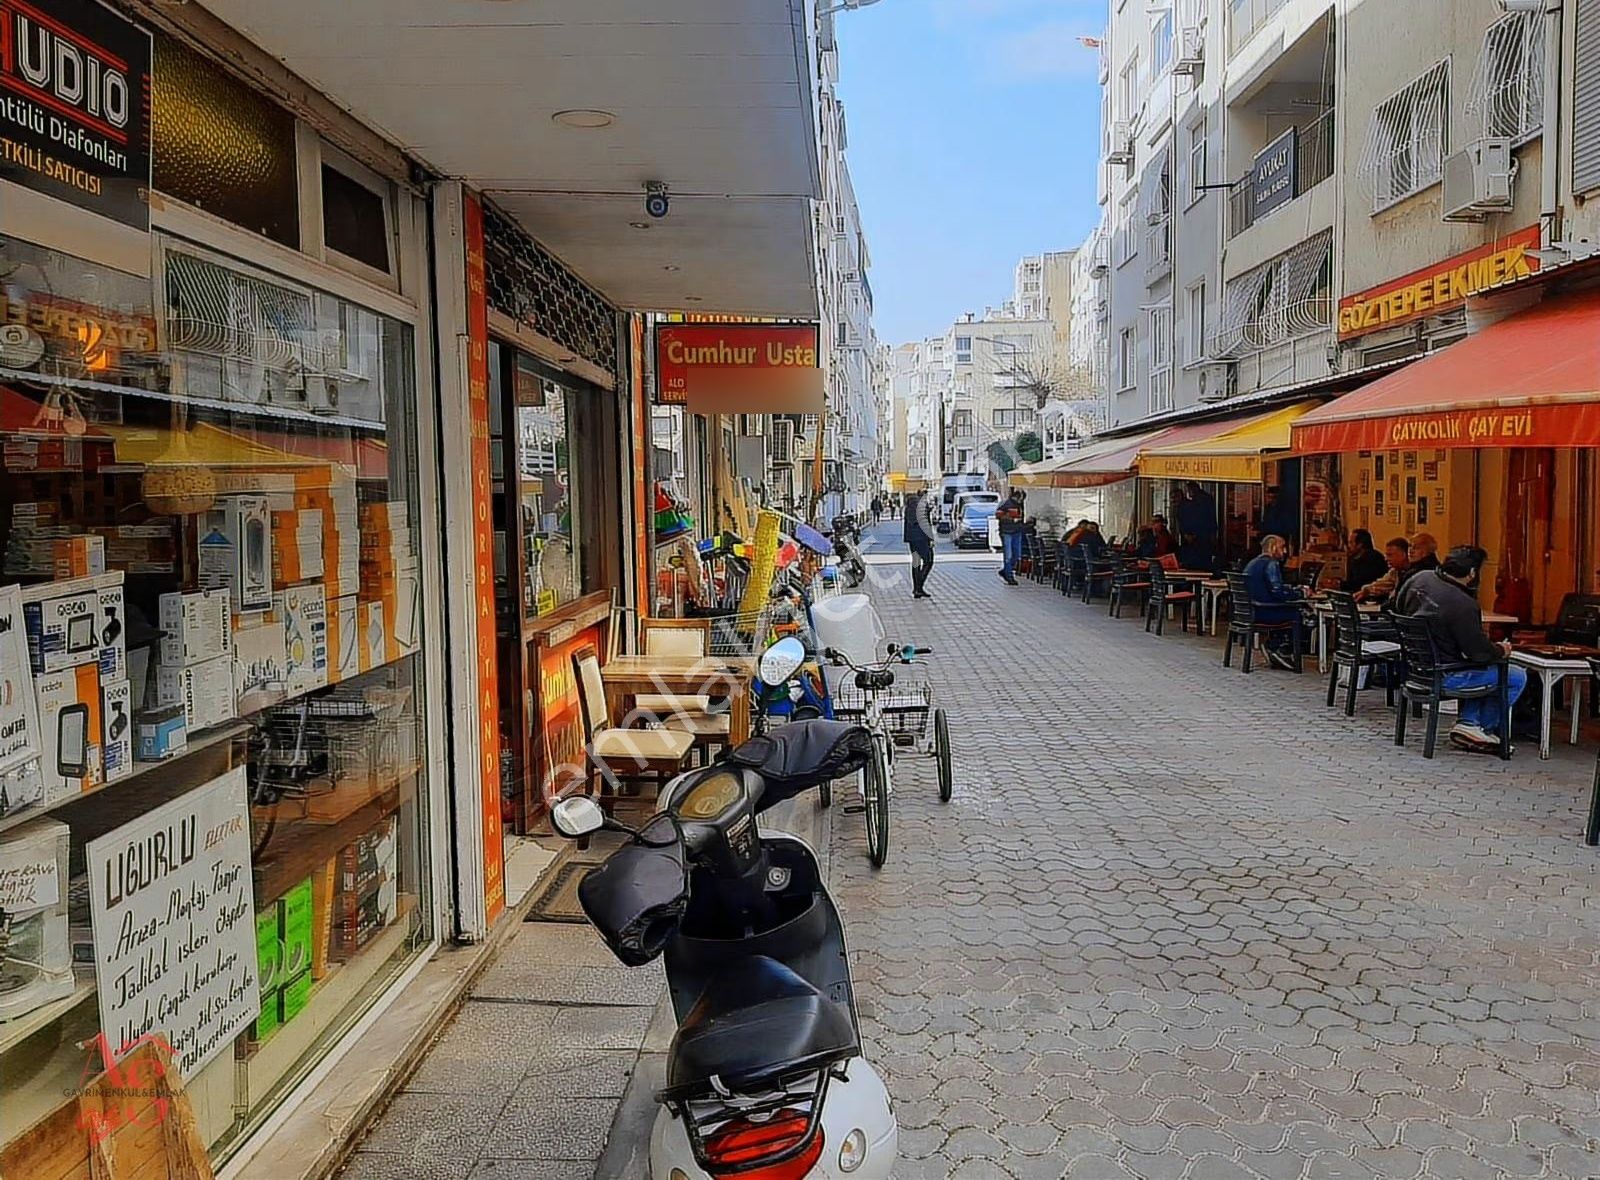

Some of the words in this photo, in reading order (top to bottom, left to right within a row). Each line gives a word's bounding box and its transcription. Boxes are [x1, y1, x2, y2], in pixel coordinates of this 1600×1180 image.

[0, 138, 42, 172] TKİLİ
[45, 158, 101, 196] SATICISI
[50, 116, 127, 172] Diafonları
[1339, 277, 1434, 333] GÖZTEPE
[1433, 241, 1532, 305] EKMEK
[668, 340, 757, 365] Cumhur
[766, 341, 815, 367] Usta
[1392, 415, 1461, 445] ÇAYKOLİK
[1469, 415, 1498, 442] ÇAY
[1501, 410, 1532, 437] EVİ
[106, 815, 195, 911] UĞURLU
